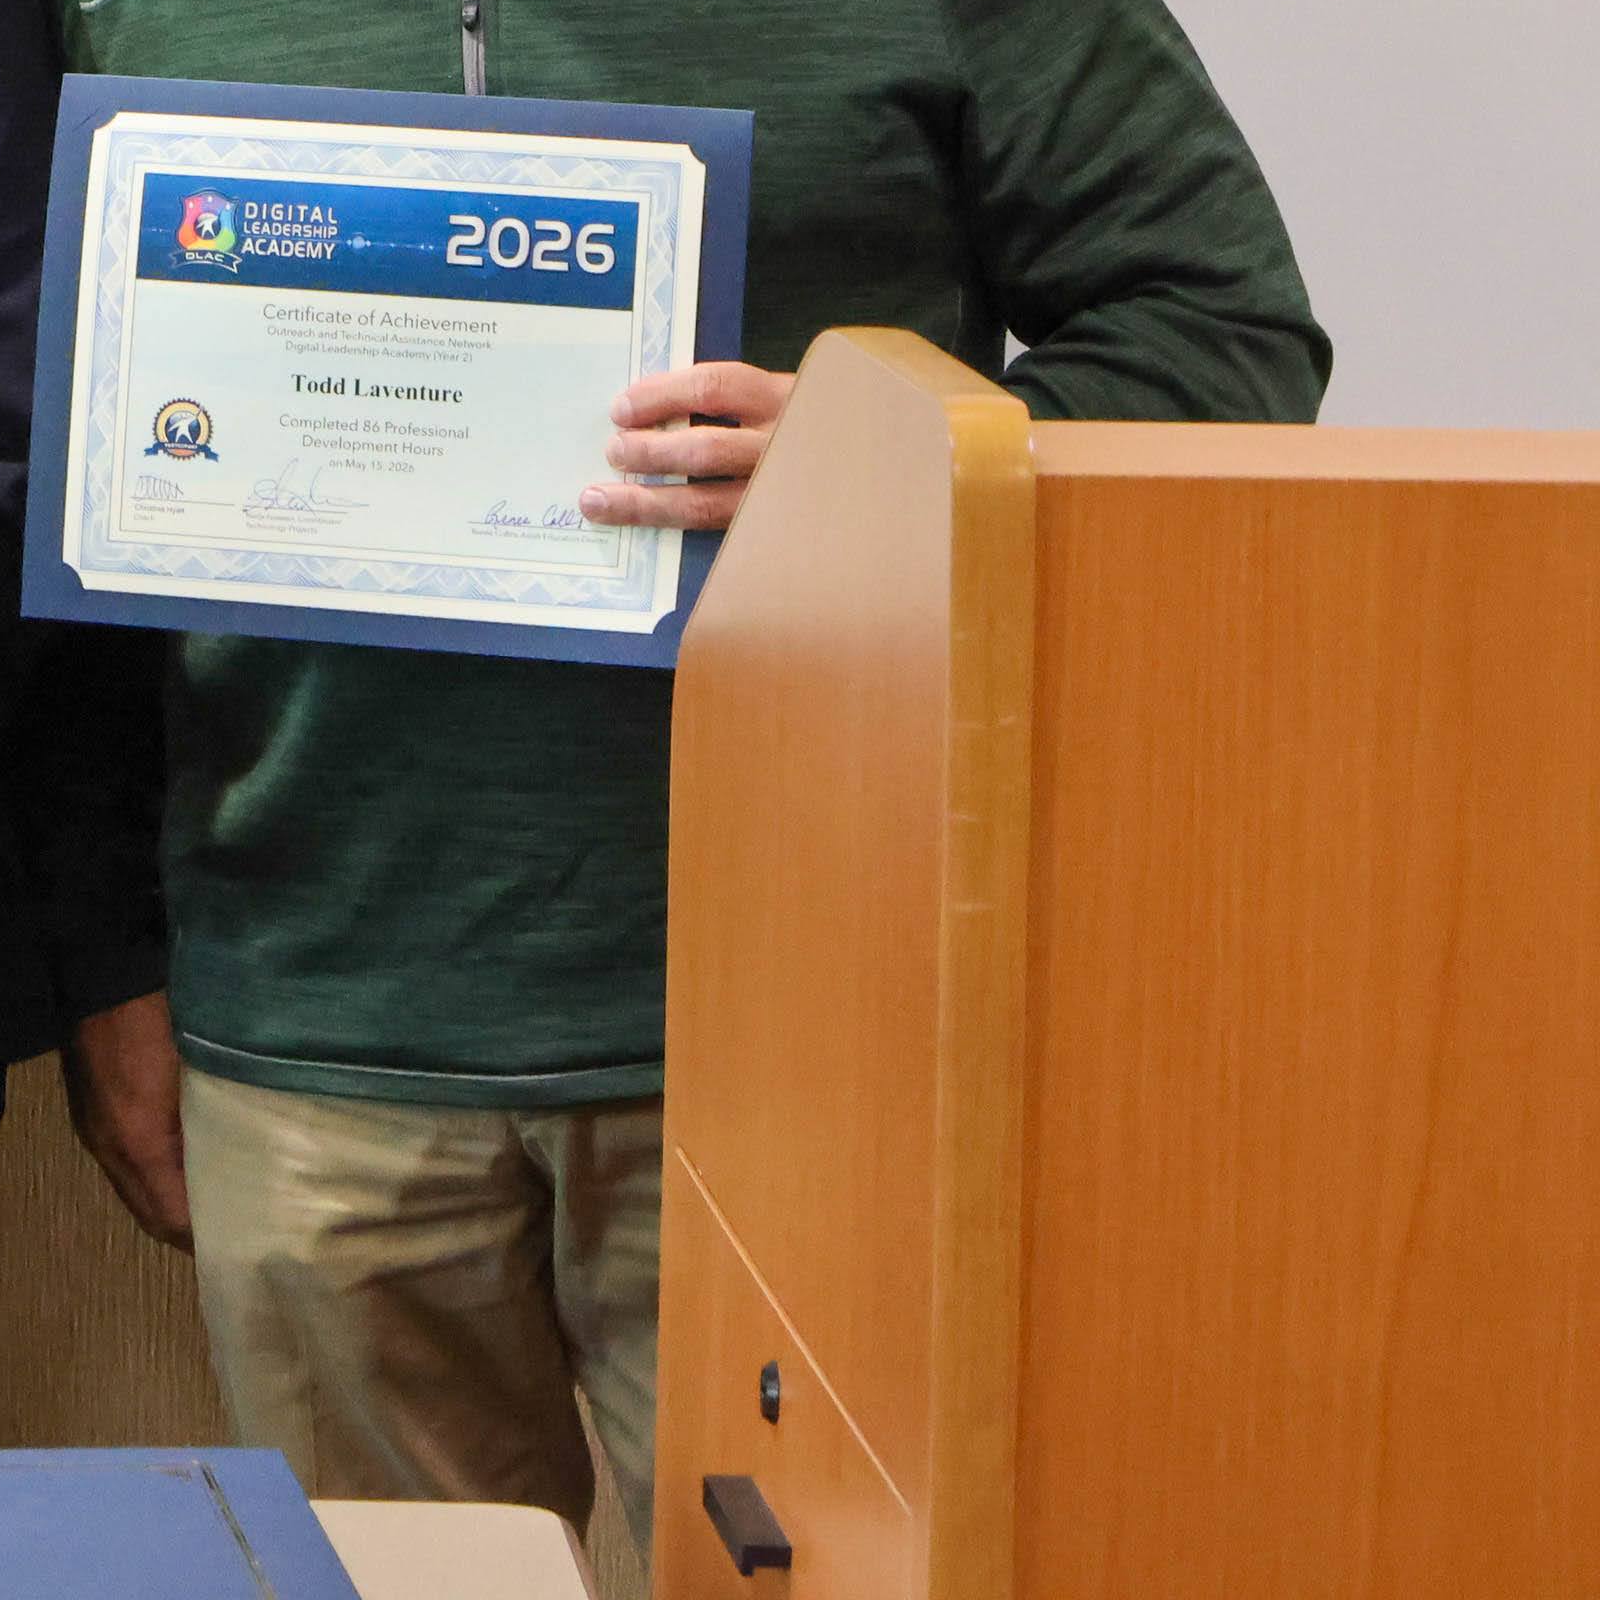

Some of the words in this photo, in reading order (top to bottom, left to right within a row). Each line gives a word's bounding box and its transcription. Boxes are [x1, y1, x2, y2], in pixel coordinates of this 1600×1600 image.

[245, 202, 338, 223] DIGITAL
[243, 222, 338, 239] LEADERSHIP
[242, 238, 335, 259] ACADEMY
[446, 214, 616, 274] 2026
[185, 252, 225, 262] DLAC
[263, 303, 352, 325] Certificate
[358, 310, 376, 326] of
[380, 311, 498, 334] Achievement
[267, 327, 315, 338] Outreach
[319, 329, 337, 340] and
[340, 331, 389, 343] Technical
[448, 338, 492, 349] Network
[285, 342, 319, 353] Digital
[322, 344, 379, 357] Leadership
[382, 348, 431, 360] Academy
[291, 373, 345, 396] Todd
[354, 378, 463, 403] Laventure
[279, 414, 358, 433] Completed
[363, 420, 380, 433] 86
[384, 422, 469, 439] Professional
[302, 435, 397, 454] Development
[402, 442, 444, 456] Hours
[329, 460, 343, 468] on
[345, 459, 367, 472] May
[388, 462, 414, 473] 2026
